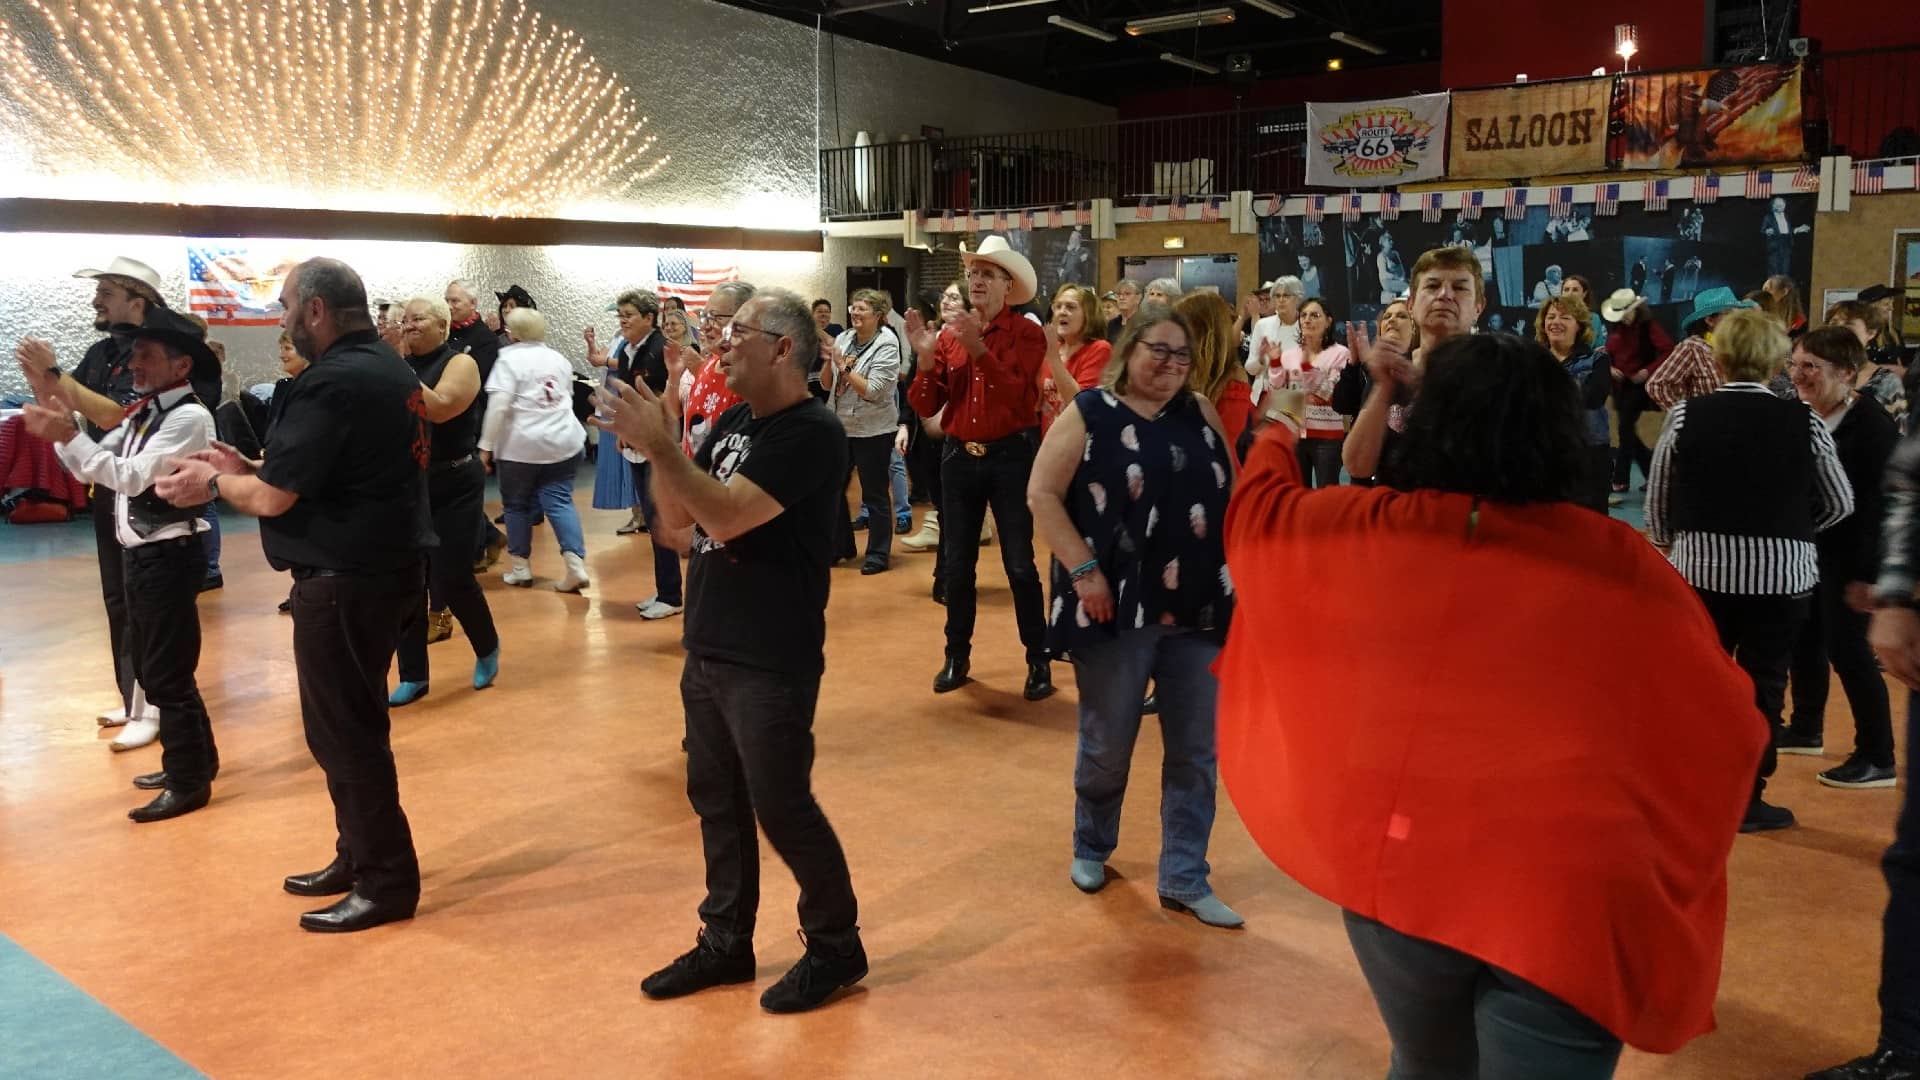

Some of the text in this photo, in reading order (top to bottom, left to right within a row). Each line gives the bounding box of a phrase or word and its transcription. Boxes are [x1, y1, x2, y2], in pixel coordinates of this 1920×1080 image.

[1361, 127, 1390, 137] ROUTE
[1466, 108, 1596, 151] SALOON
[1361, 138, 1389, 157] 66
